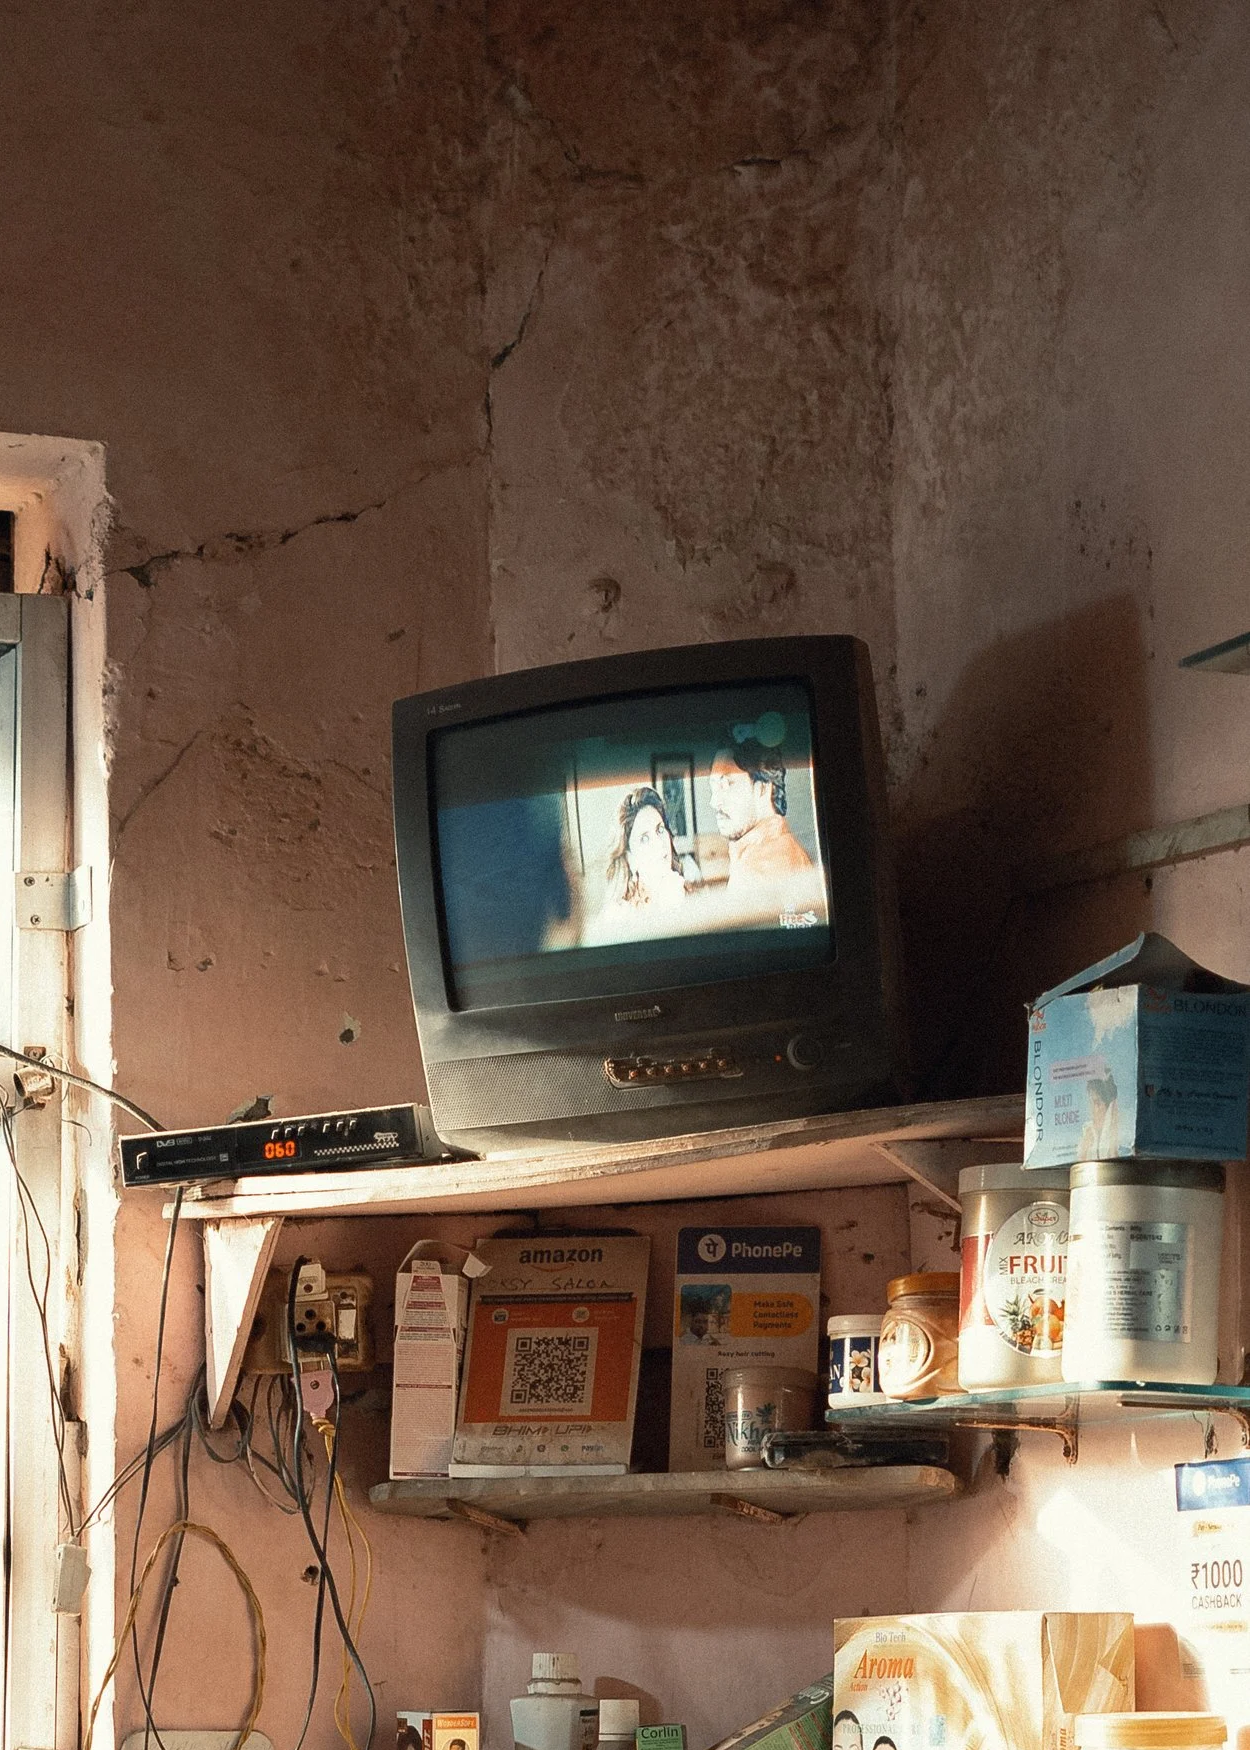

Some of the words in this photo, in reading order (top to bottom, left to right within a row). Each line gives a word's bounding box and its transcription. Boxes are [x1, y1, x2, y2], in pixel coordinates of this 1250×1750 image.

[1033, 1039, 1044, 1143] BLONDOR
[1054, 1110, 1080, 1126] BLONDE
[518, 1248, 604, 1265] amazon
[731, 1241, 803, 1258] PhonePe
[1010, 1255, 1068, 1275] FRUI
[753, 1300, 775, 1308] Make
[776, 1300, 794, 1308] Safe
[753, 1311, 799, 1319] Contactless
[753, 1321, 792, 1331] Payments
[492, 1424, 543, 1437] BHIM
[554, 1424, 588, 1436] UPI
[1190, 1559, 1243, 1590] ₹1000
[1191, 1593, 1242, 1610] CASHBACK
[875, 1631, 888, 1643] Bio
[890, 1631, 906, 1643] Tech
[853, 1648, 915, 1680] Aroma
[640, 1726, 679, 1740] Corlin
